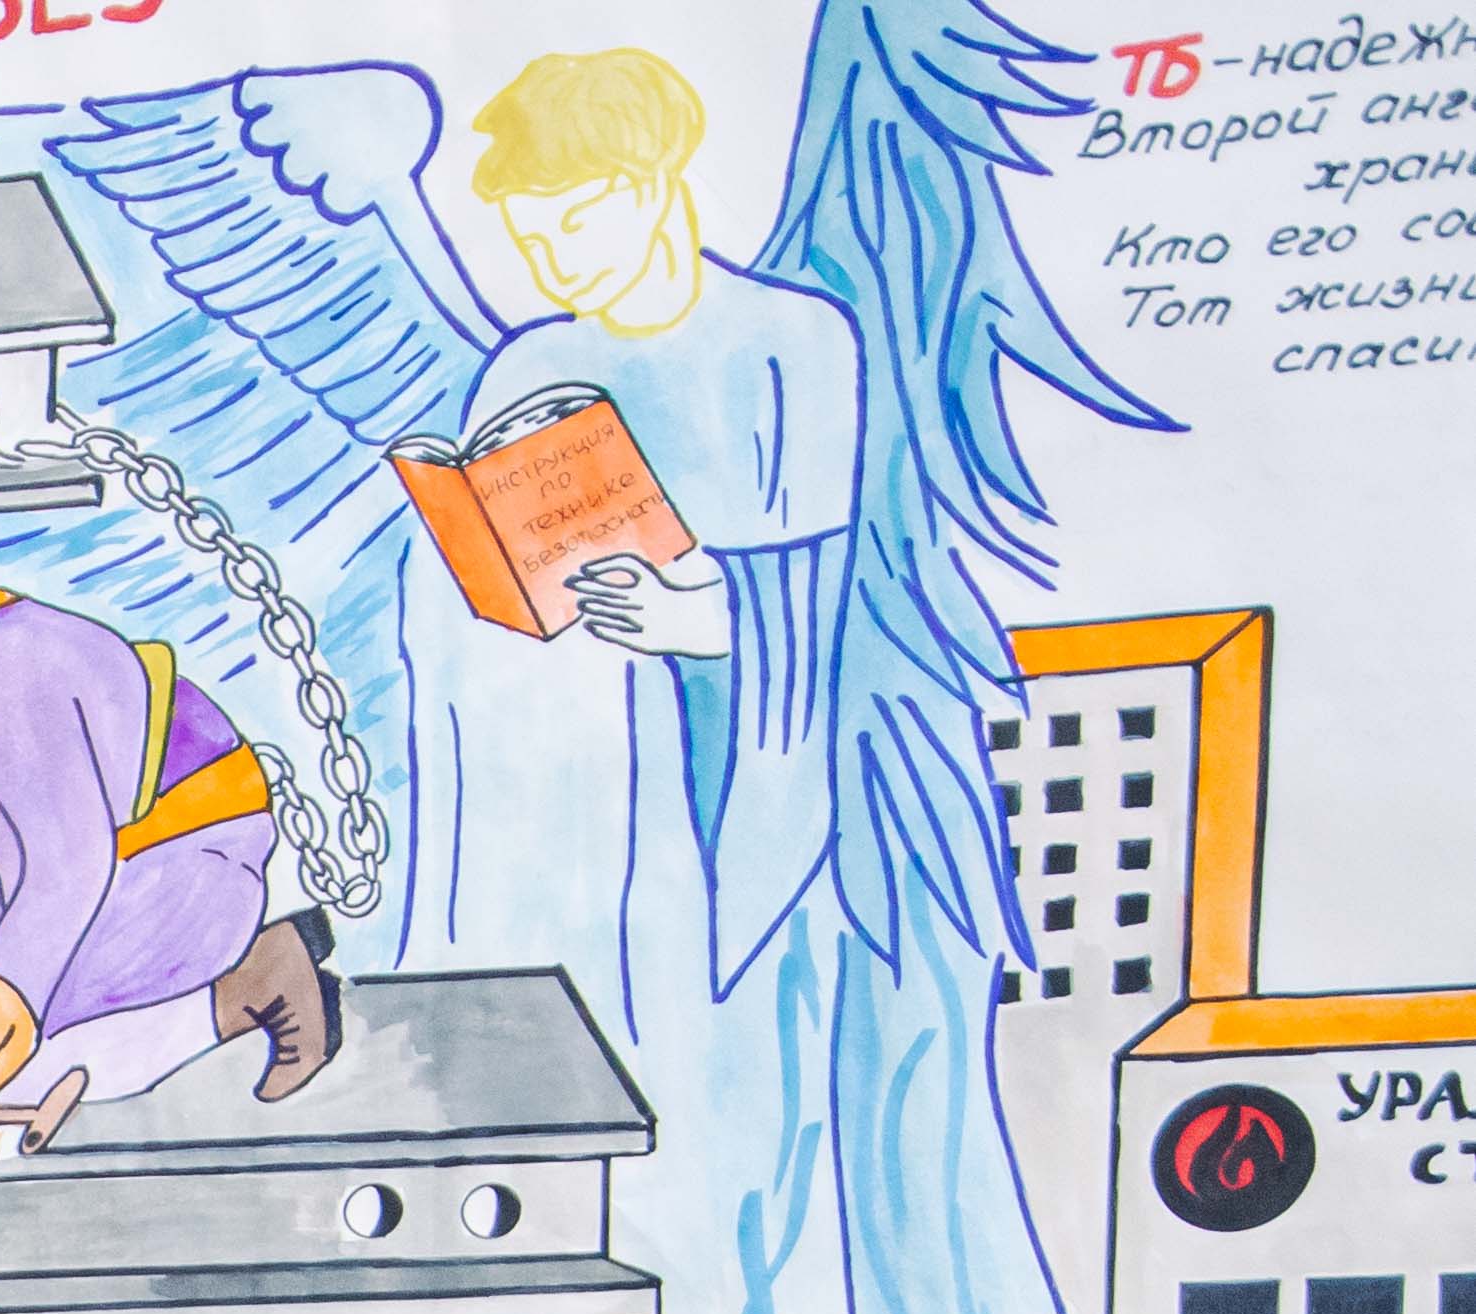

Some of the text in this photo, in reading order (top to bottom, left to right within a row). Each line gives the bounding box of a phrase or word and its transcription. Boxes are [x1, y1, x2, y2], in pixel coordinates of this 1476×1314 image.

[1111, 32, 1204, 98] ТБ
[1077, 88, 1476, 162] Второй анг
[1303, 149, 1476, 204] хран
[1103, 223, 1357, 267] Кто его
[1123, 284, 1232, 328] Тот
[1272, 335, 1476, 374] спаси
[479, 423, 616, 501] ИНСТРУКЦИЯ
